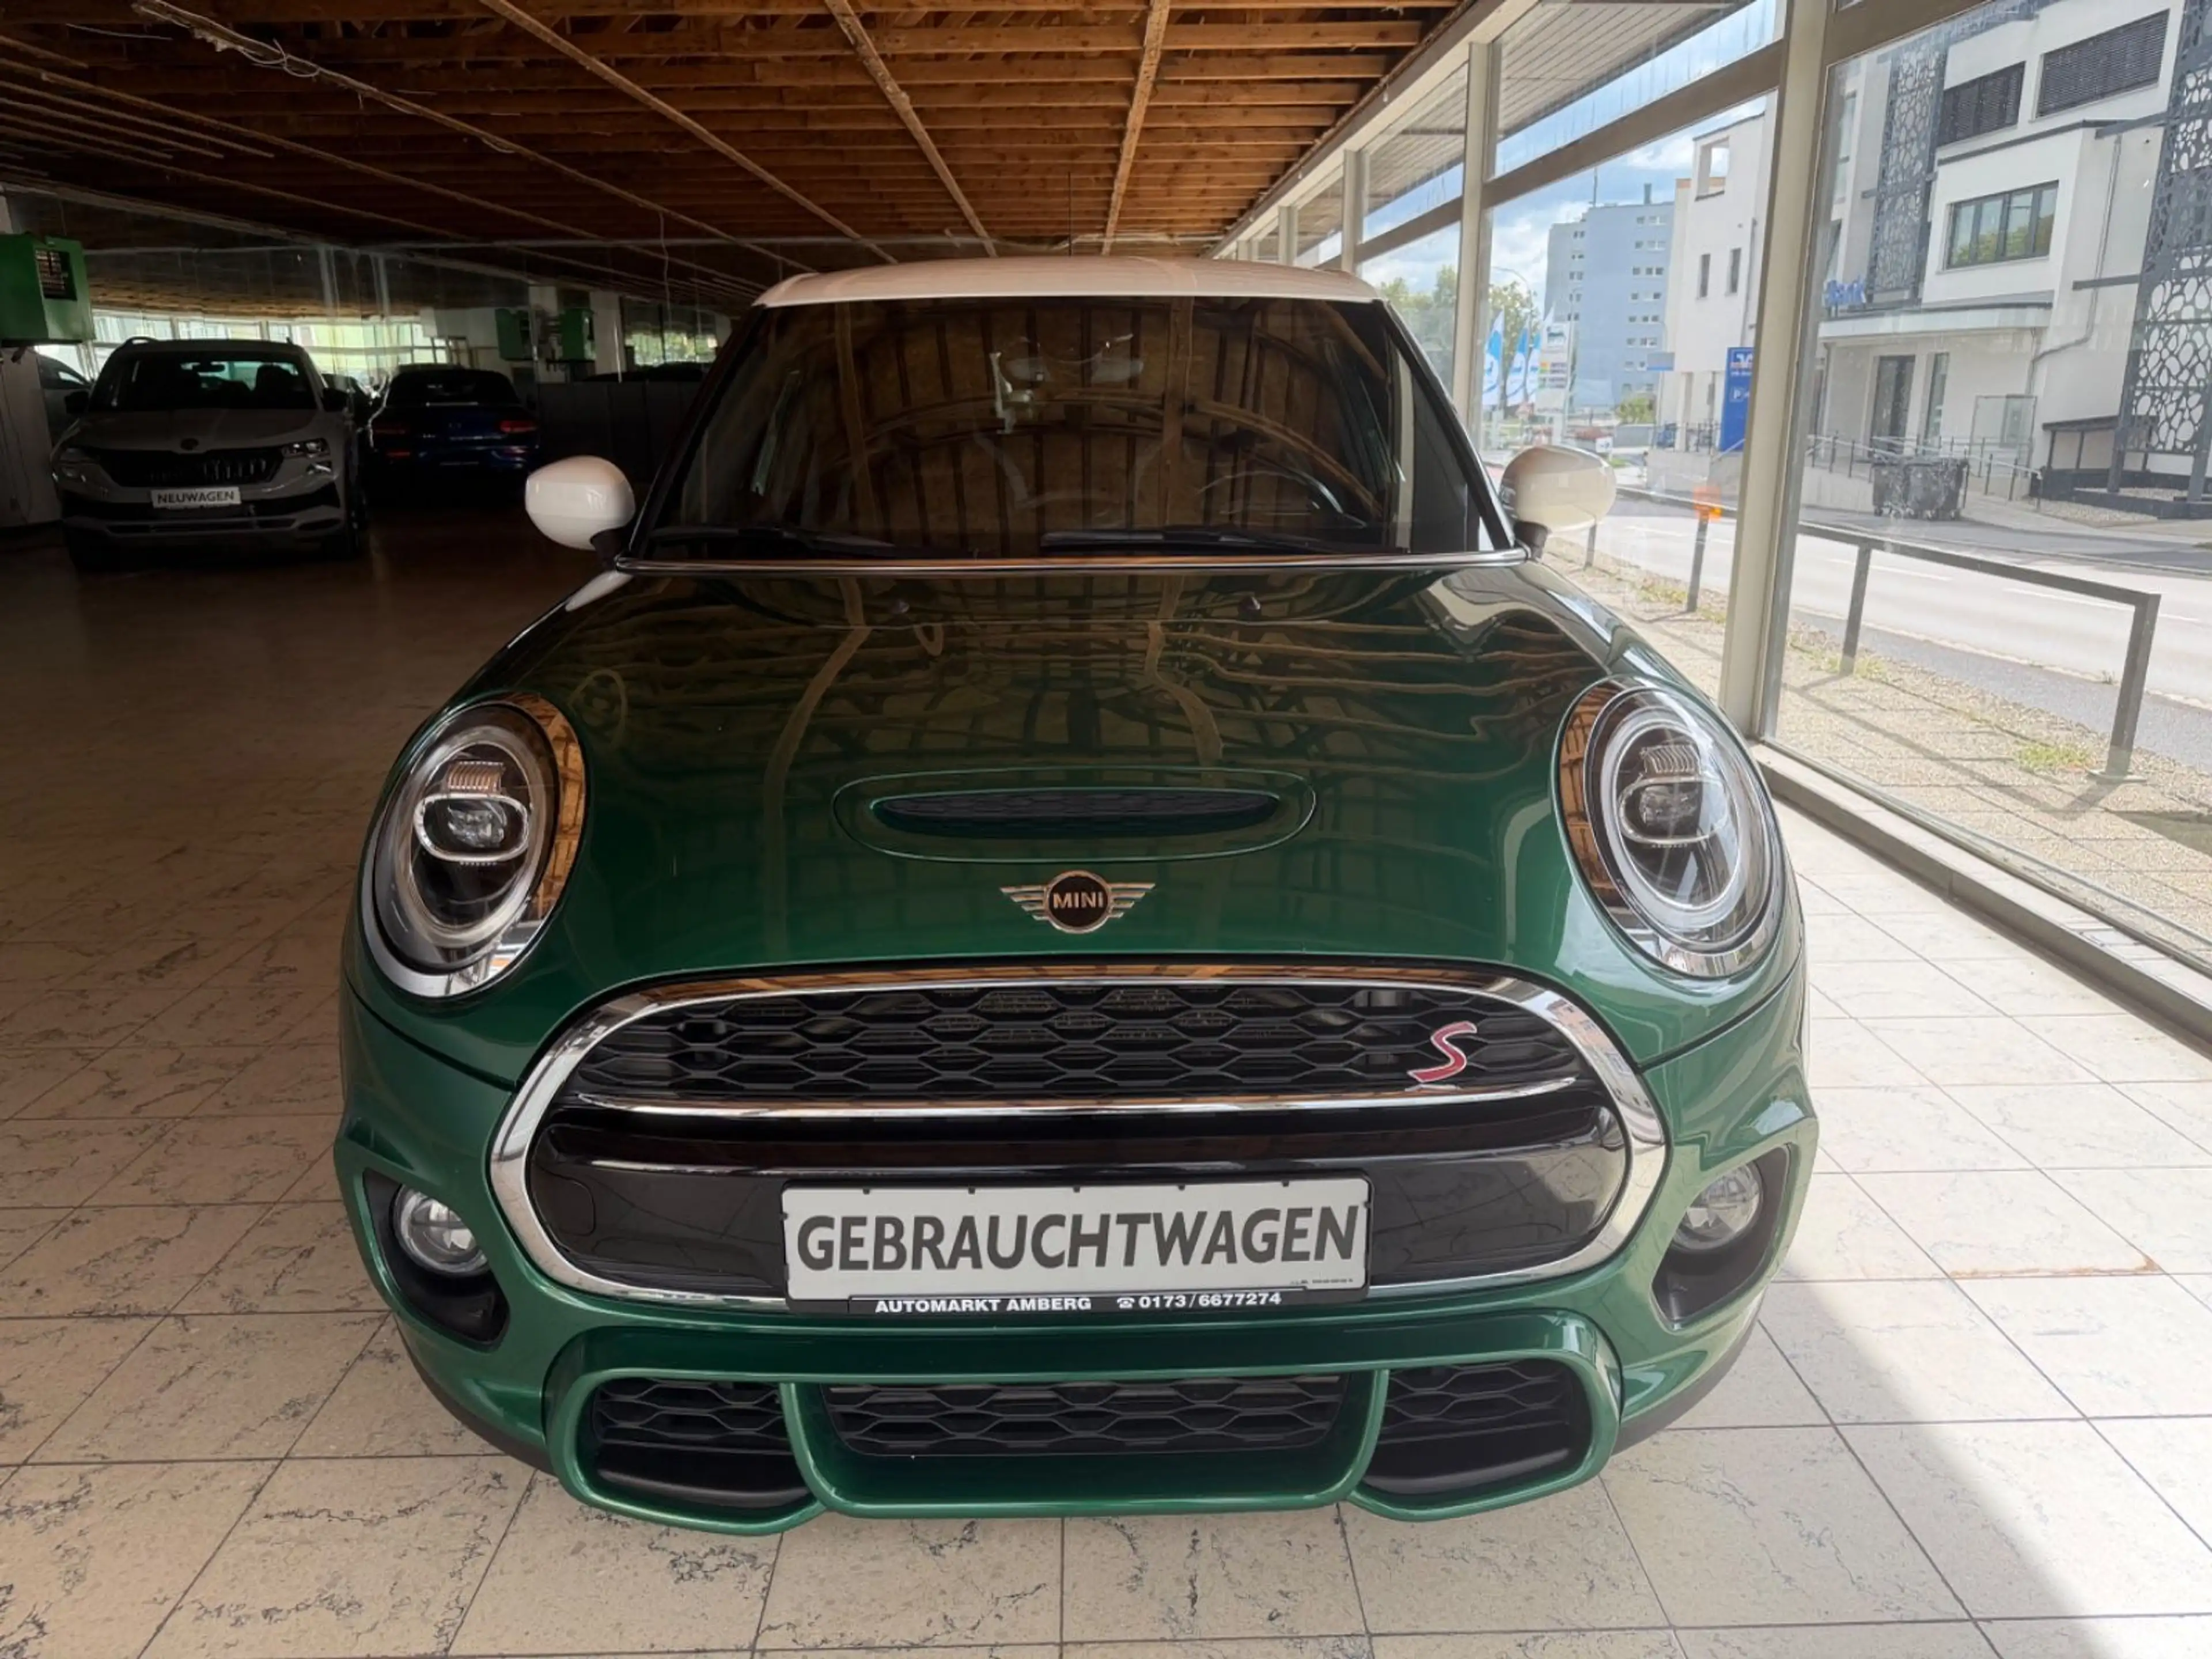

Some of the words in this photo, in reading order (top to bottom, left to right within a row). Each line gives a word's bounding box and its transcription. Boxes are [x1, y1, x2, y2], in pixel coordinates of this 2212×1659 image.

[157, 491, 234, 504] NEUWAGEN
[1053, 892, 1104, 908] MINI
[1407, 1020, 1478, 1083] S
[797, 1205, 1359, 1271] GEBRAUCHTWAGEN
[875, 1300, 1001, 1313] AUTOMARKT
[1006, 1298, 1092, 1311] AMBERG
